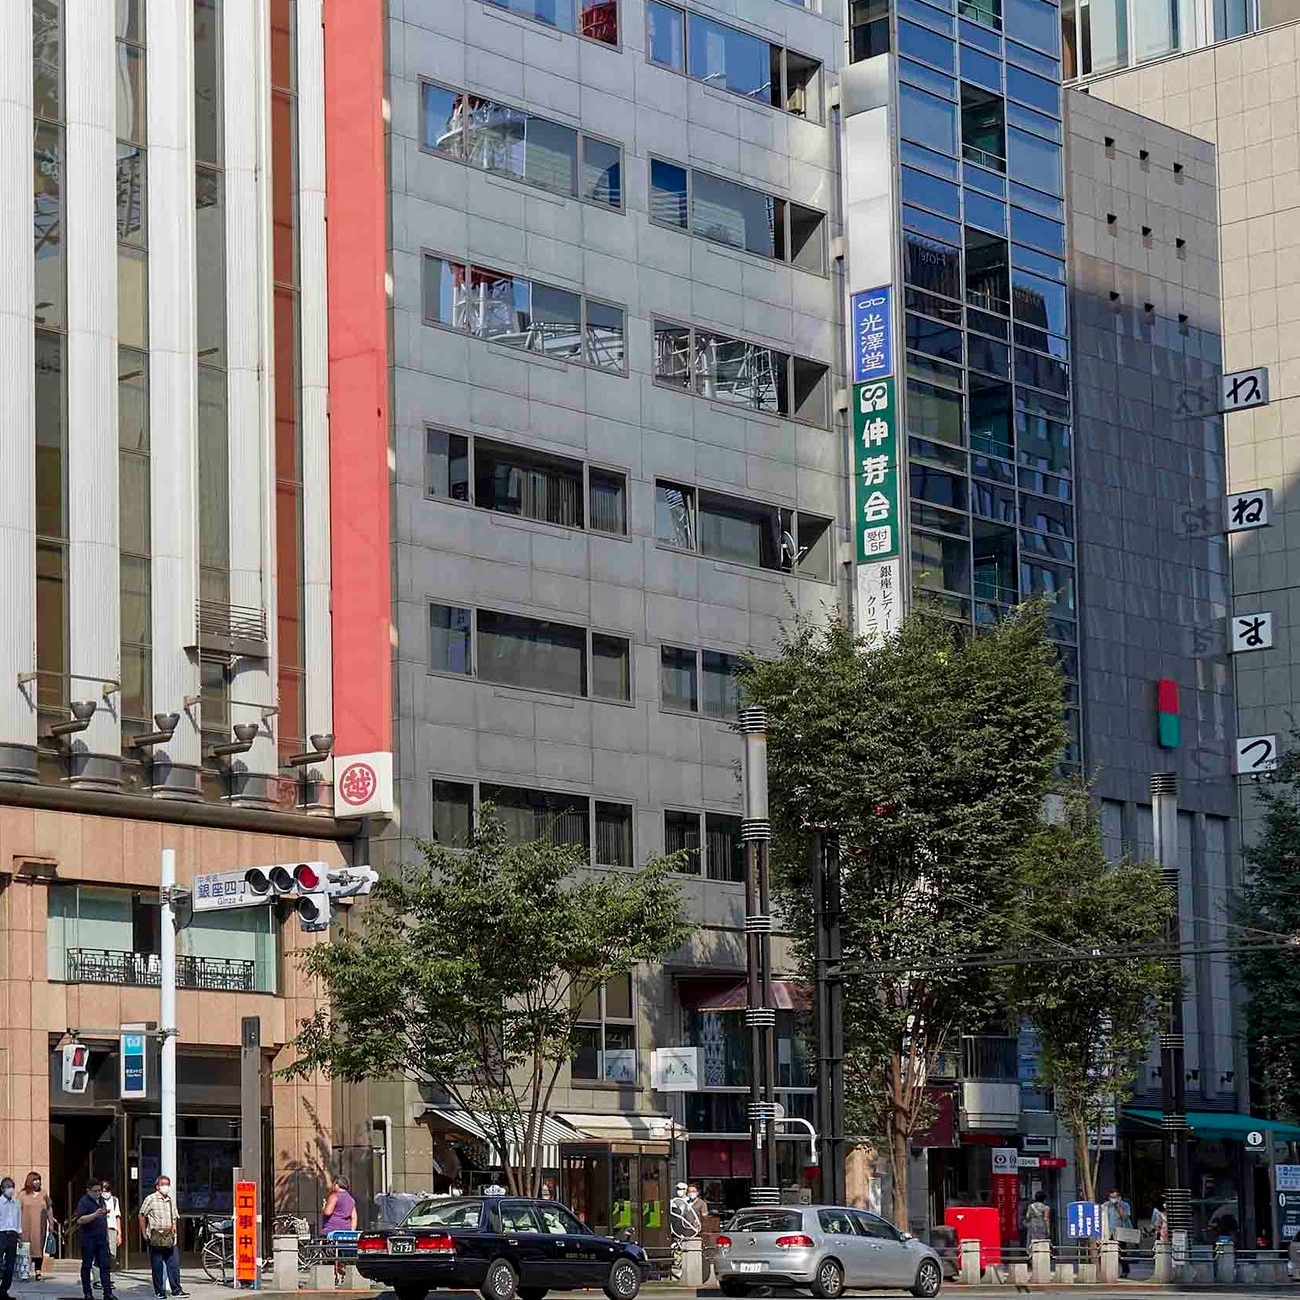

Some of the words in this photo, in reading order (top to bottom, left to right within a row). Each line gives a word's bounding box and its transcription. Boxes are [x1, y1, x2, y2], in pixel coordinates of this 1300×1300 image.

[859, 313, 886, 373] 光澤堂
[862, 419, 890, 522] 伸芽会
[867, 529, 888, 544] 受付
[869, 540, 886, 553] 5F
[198, 880, 247, 898] 銀座四丁
[238, 1195, 254, 1250] 工事中
